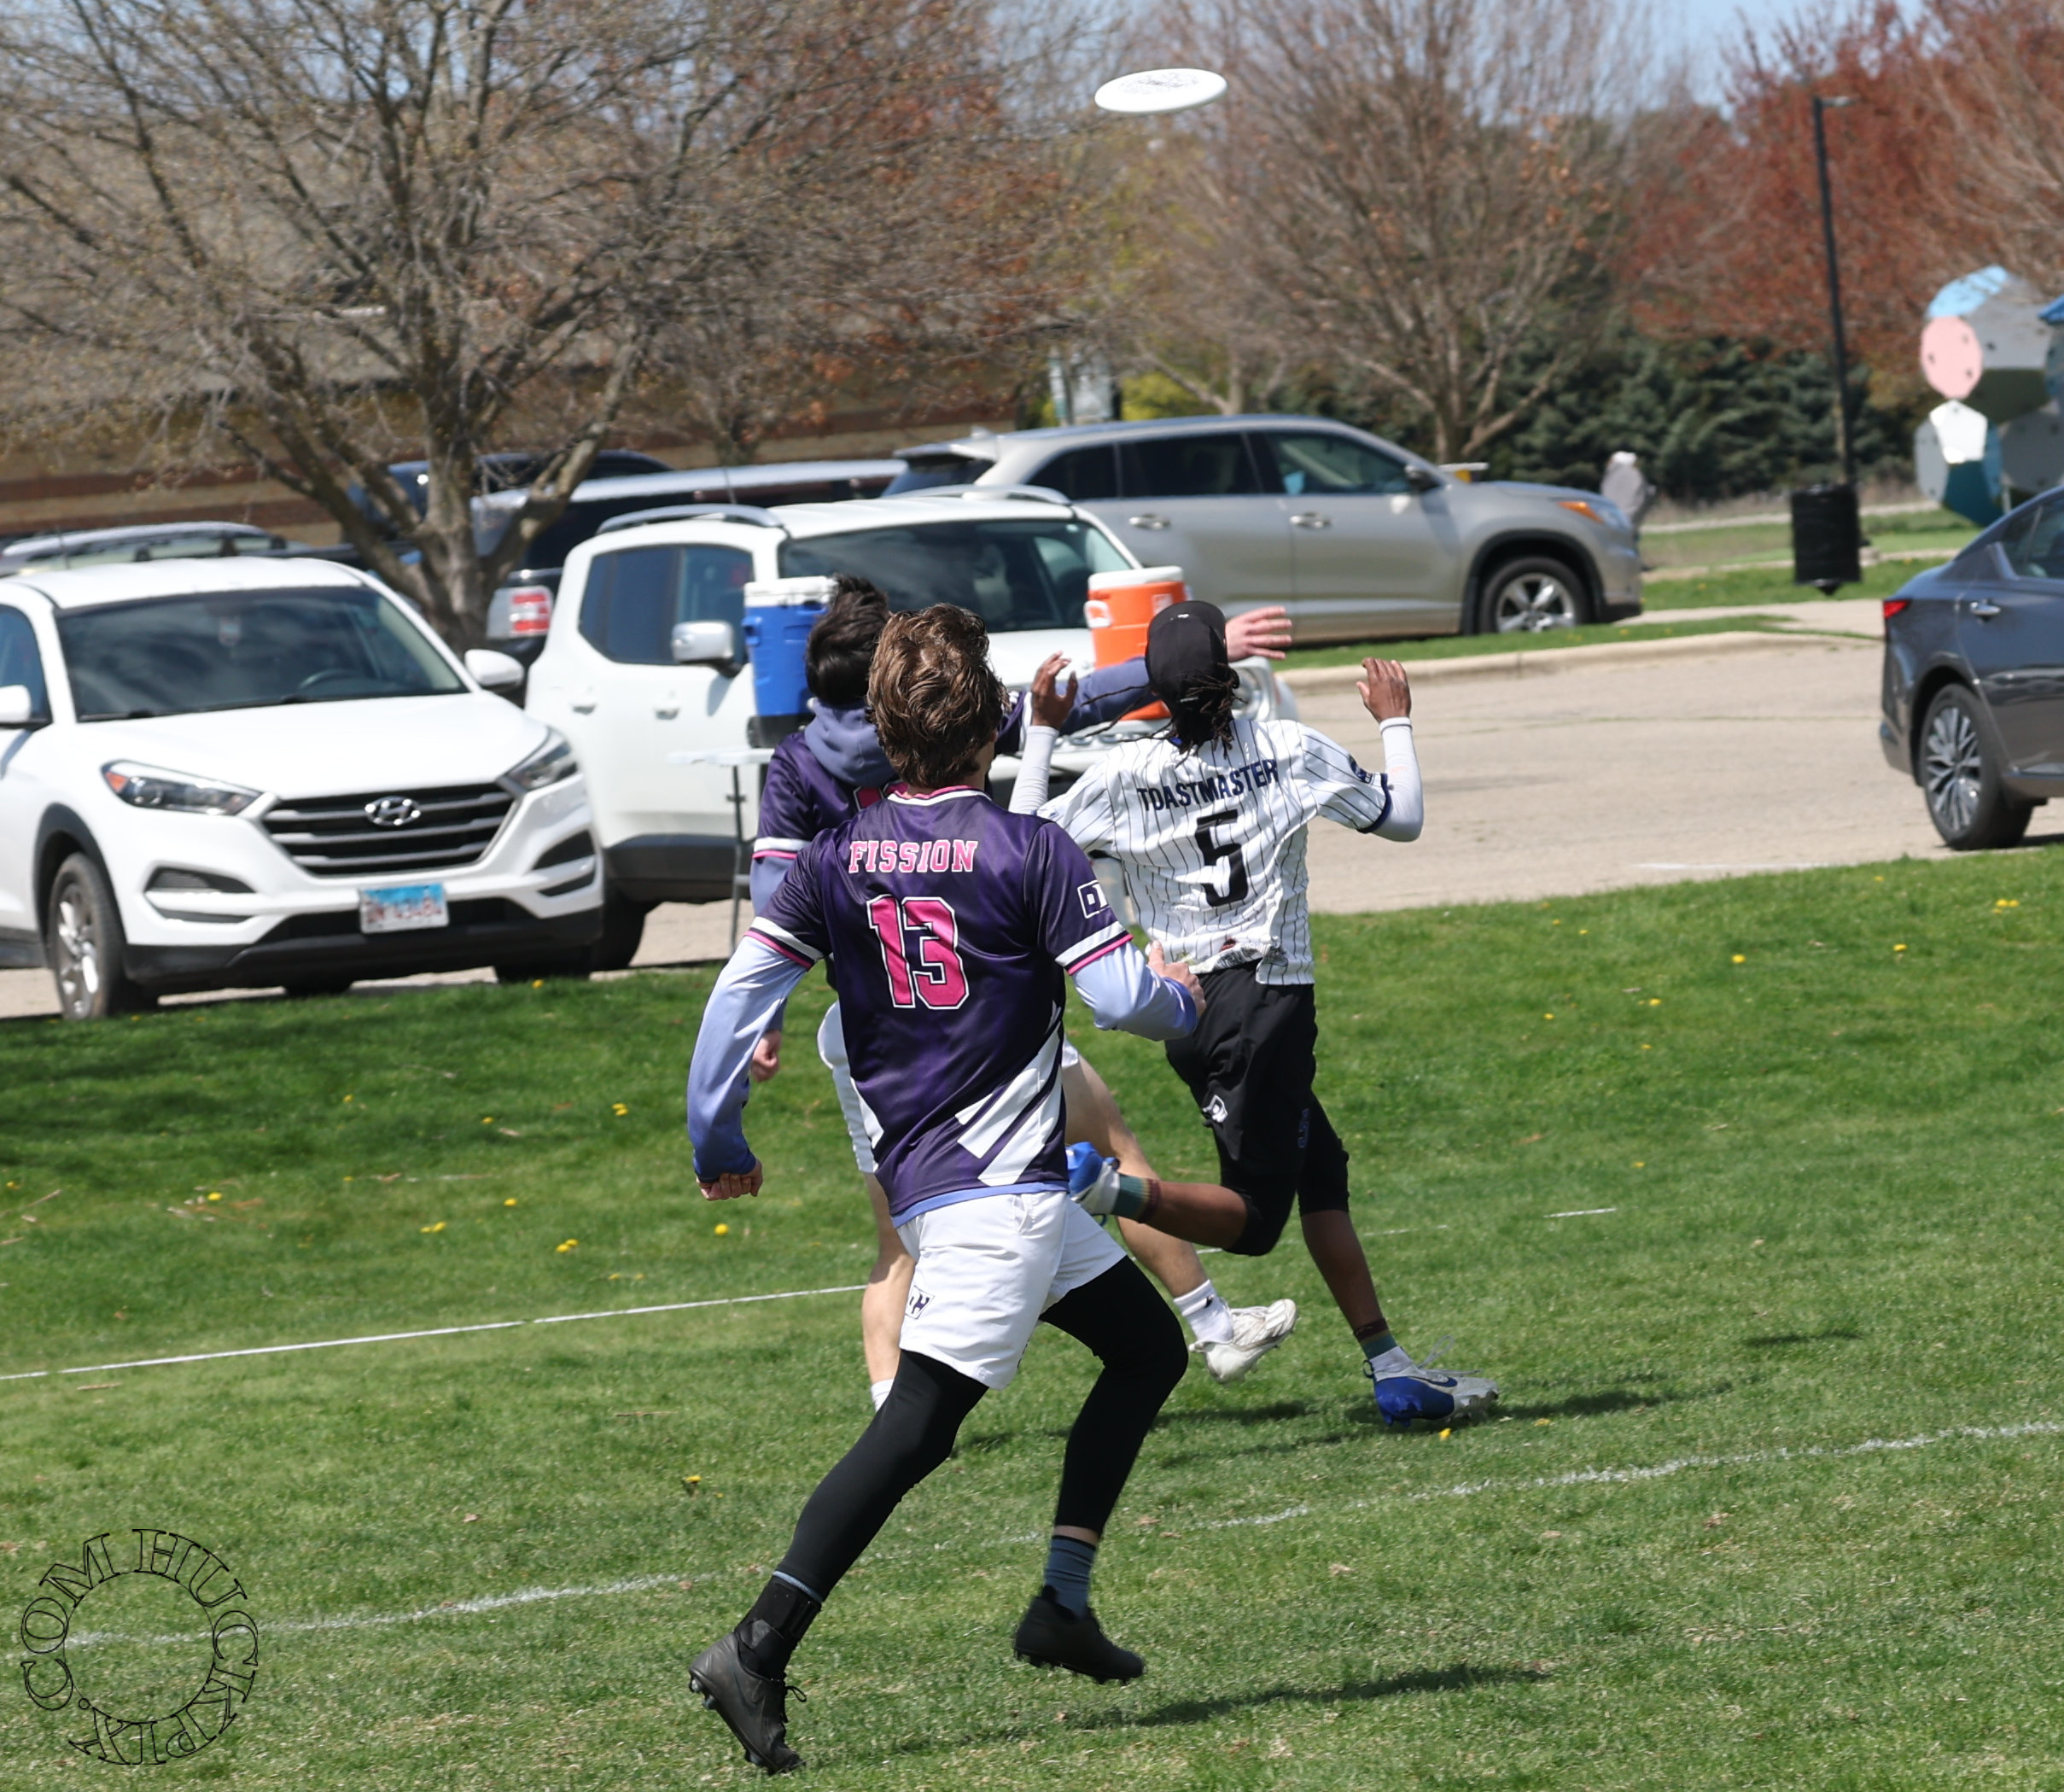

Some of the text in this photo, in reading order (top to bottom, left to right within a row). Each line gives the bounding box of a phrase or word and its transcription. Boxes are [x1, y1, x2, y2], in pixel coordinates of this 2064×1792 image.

[1138, 760, 1279, 811] TOASTMASTER
[848, 839, 978, 873] FISSION
[1195, 809, 1249, 907] 5
[866, 894, 970, 1010] 13
